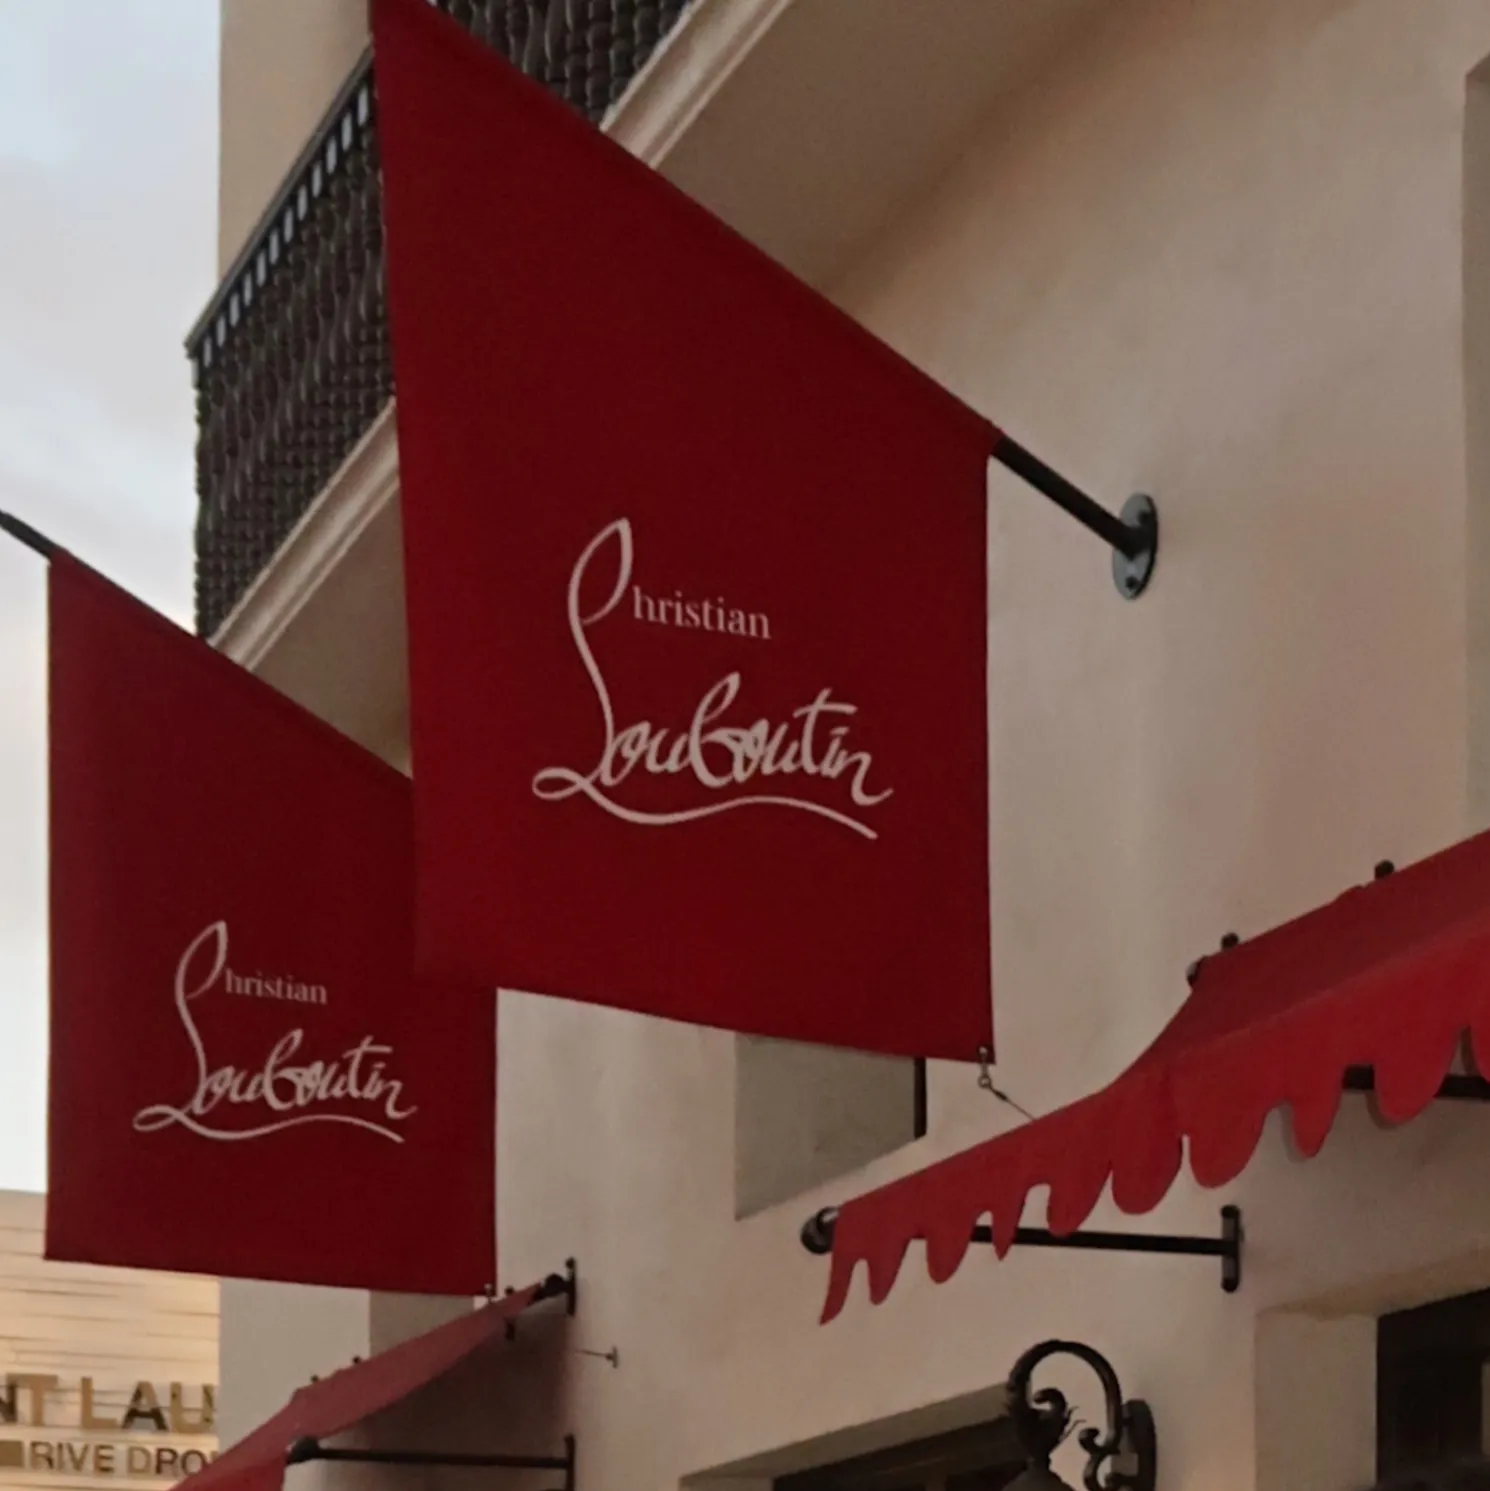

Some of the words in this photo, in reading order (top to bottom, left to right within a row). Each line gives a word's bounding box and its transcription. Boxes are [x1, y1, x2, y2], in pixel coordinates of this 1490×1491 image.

[531, 516, 894, 840] Louboutin
[132, 919, 418, 1143] Louboutin
[30, 1441, 116, 1474] RIVE
